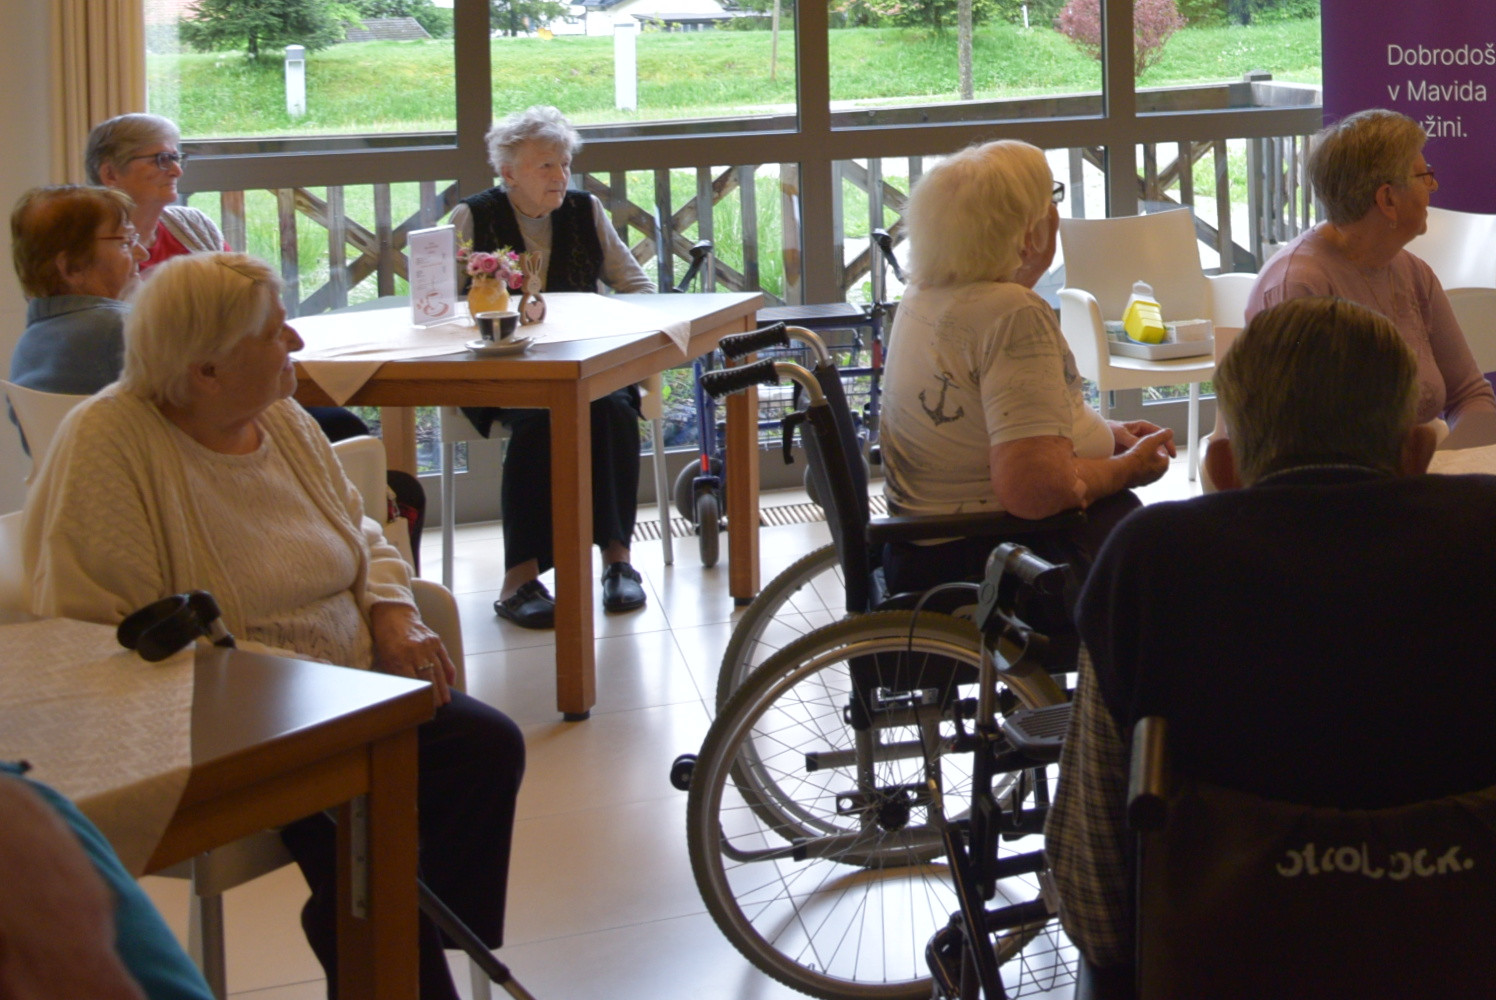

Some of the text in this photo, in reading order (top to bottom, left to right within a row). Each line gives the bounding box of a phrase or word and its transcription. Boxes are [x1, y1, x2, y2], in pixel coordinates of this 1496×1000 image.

[1388, 80, 1487, 102] v Mavida
[1420, 115, 1468, 138] žini.
